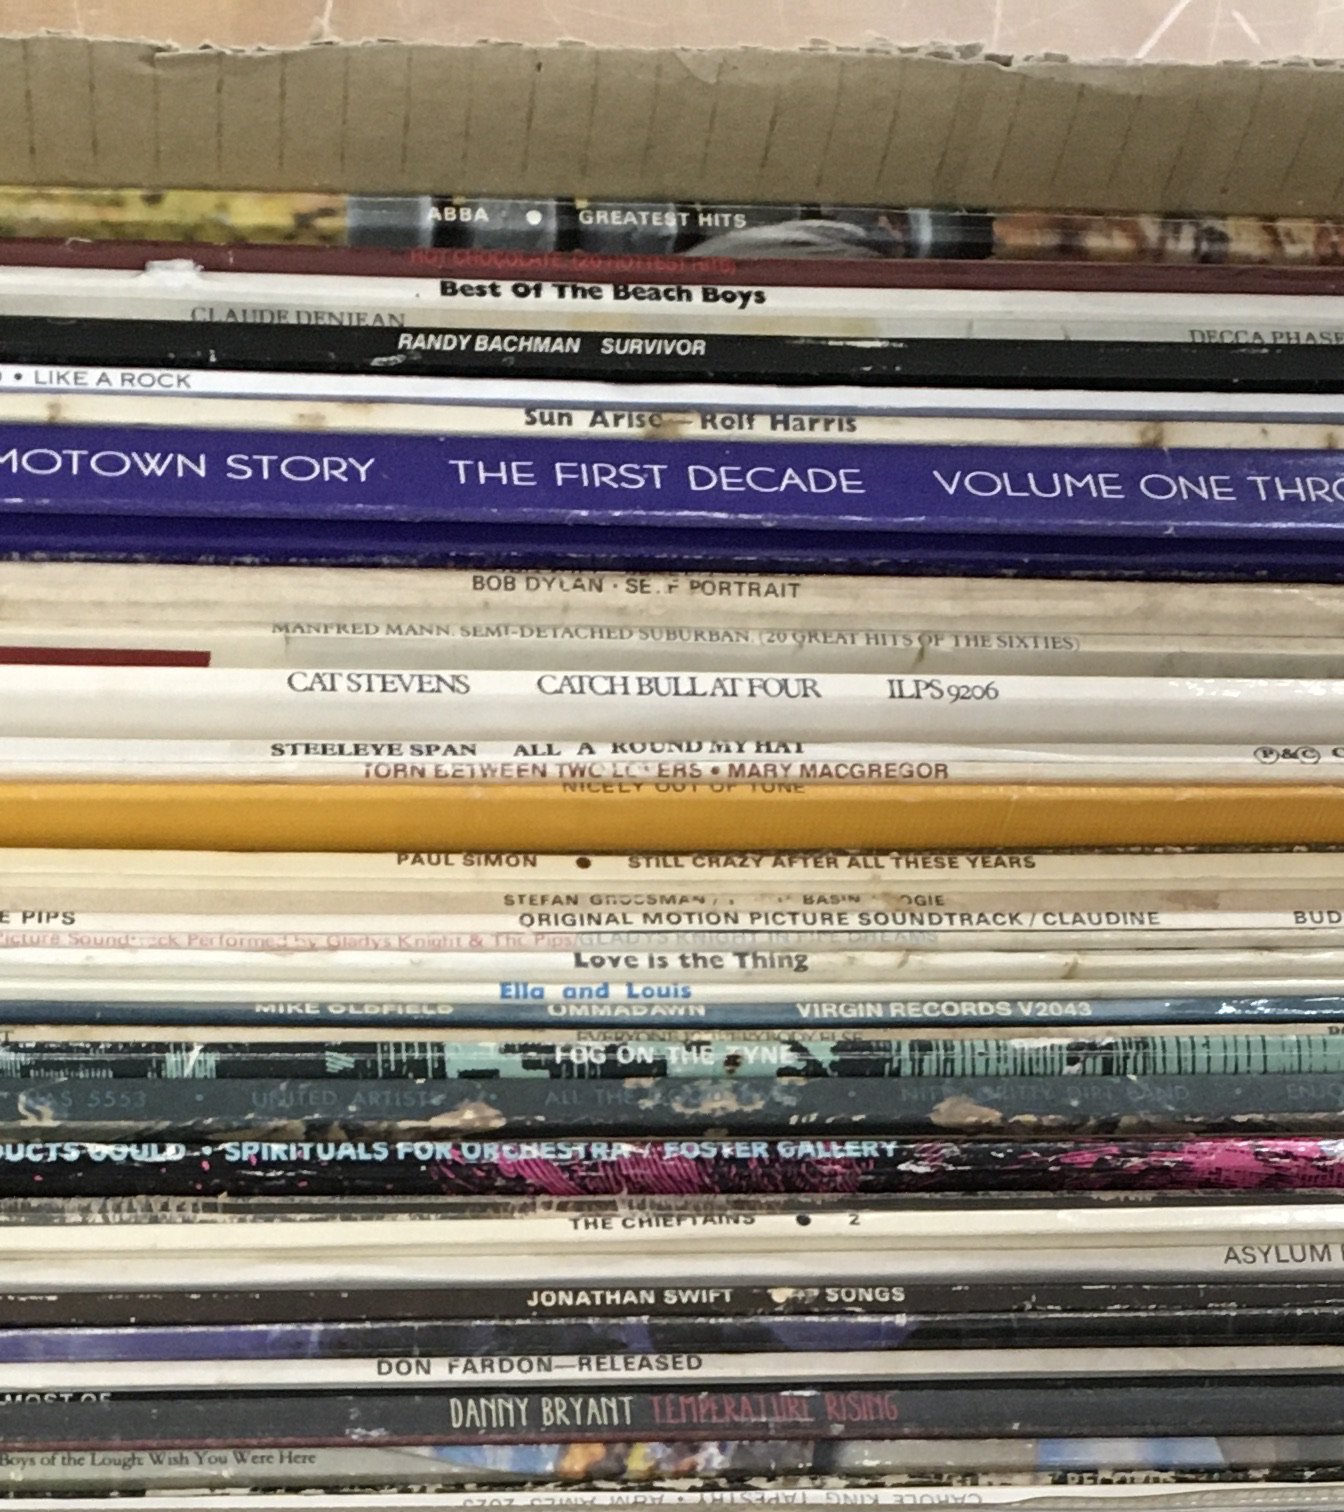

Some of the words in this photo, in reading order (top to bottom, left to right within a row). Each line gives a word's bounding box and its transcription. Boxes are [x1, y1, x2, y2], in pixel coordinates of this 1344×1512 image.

[427, 206, 489, 223] ABBA
[578, 209, 690, 228] GREATEST
[698, 211, 746, 228] HITS
[440, 280, 501, 298] Best
[512, 281, 543, 299] Of
[553, 284, 603, 301] The
[612, 285, 692, 303] Beach
[702, 286, 766, 309] Boys
[398, 333, 471, 351] RANDY
[474, 334, 581, 353] BACHMAN
[601, 338, 706, 356] SURVIVOR
[34, 369, 90, 385] LIKE
[96, 371, 114, 386] A
[120, 372, 191, 389] ROCK
[226, 455, 374, 482] STORY
[448, 460, 537, 485] THE
[555, 462, 668, 490] FIRST
[688, 465, 865, 494] DECADE
[932, 470, 1125, 499] VOLUME
[1139, 474, 1236, 501] ONE
[287, 672, 341, 693] CAT
[347, 673, 470, 694] STEVENS
[537, 675, 631, 696] CATCH
[747, 677, 821, 699] FOUR
[887, 679, 944, 699] ILPS
[947, 681, 999, 703] 9206
[270, 742, 403, 757] STEELEYE
[410, 743, 476, 757] SPAN
[727, 762, 793, 779] MARY
[799, 763, 949, 779] MACGREGOR
[573, 952, 640, 969] Love
[678, 952, 725, 969] the
[731, 952, 809, 973] Thing
[499, 982, 545, 1000] Ella
[562, 982, 610, 999] and
[626, 983, 691, 1000] Louis
[1224, 1245, 1332, 1265] ASYLUM
[449, 1397, 527, 1428] DANNY
[541, 1395, 634, 1426] BRYANT
